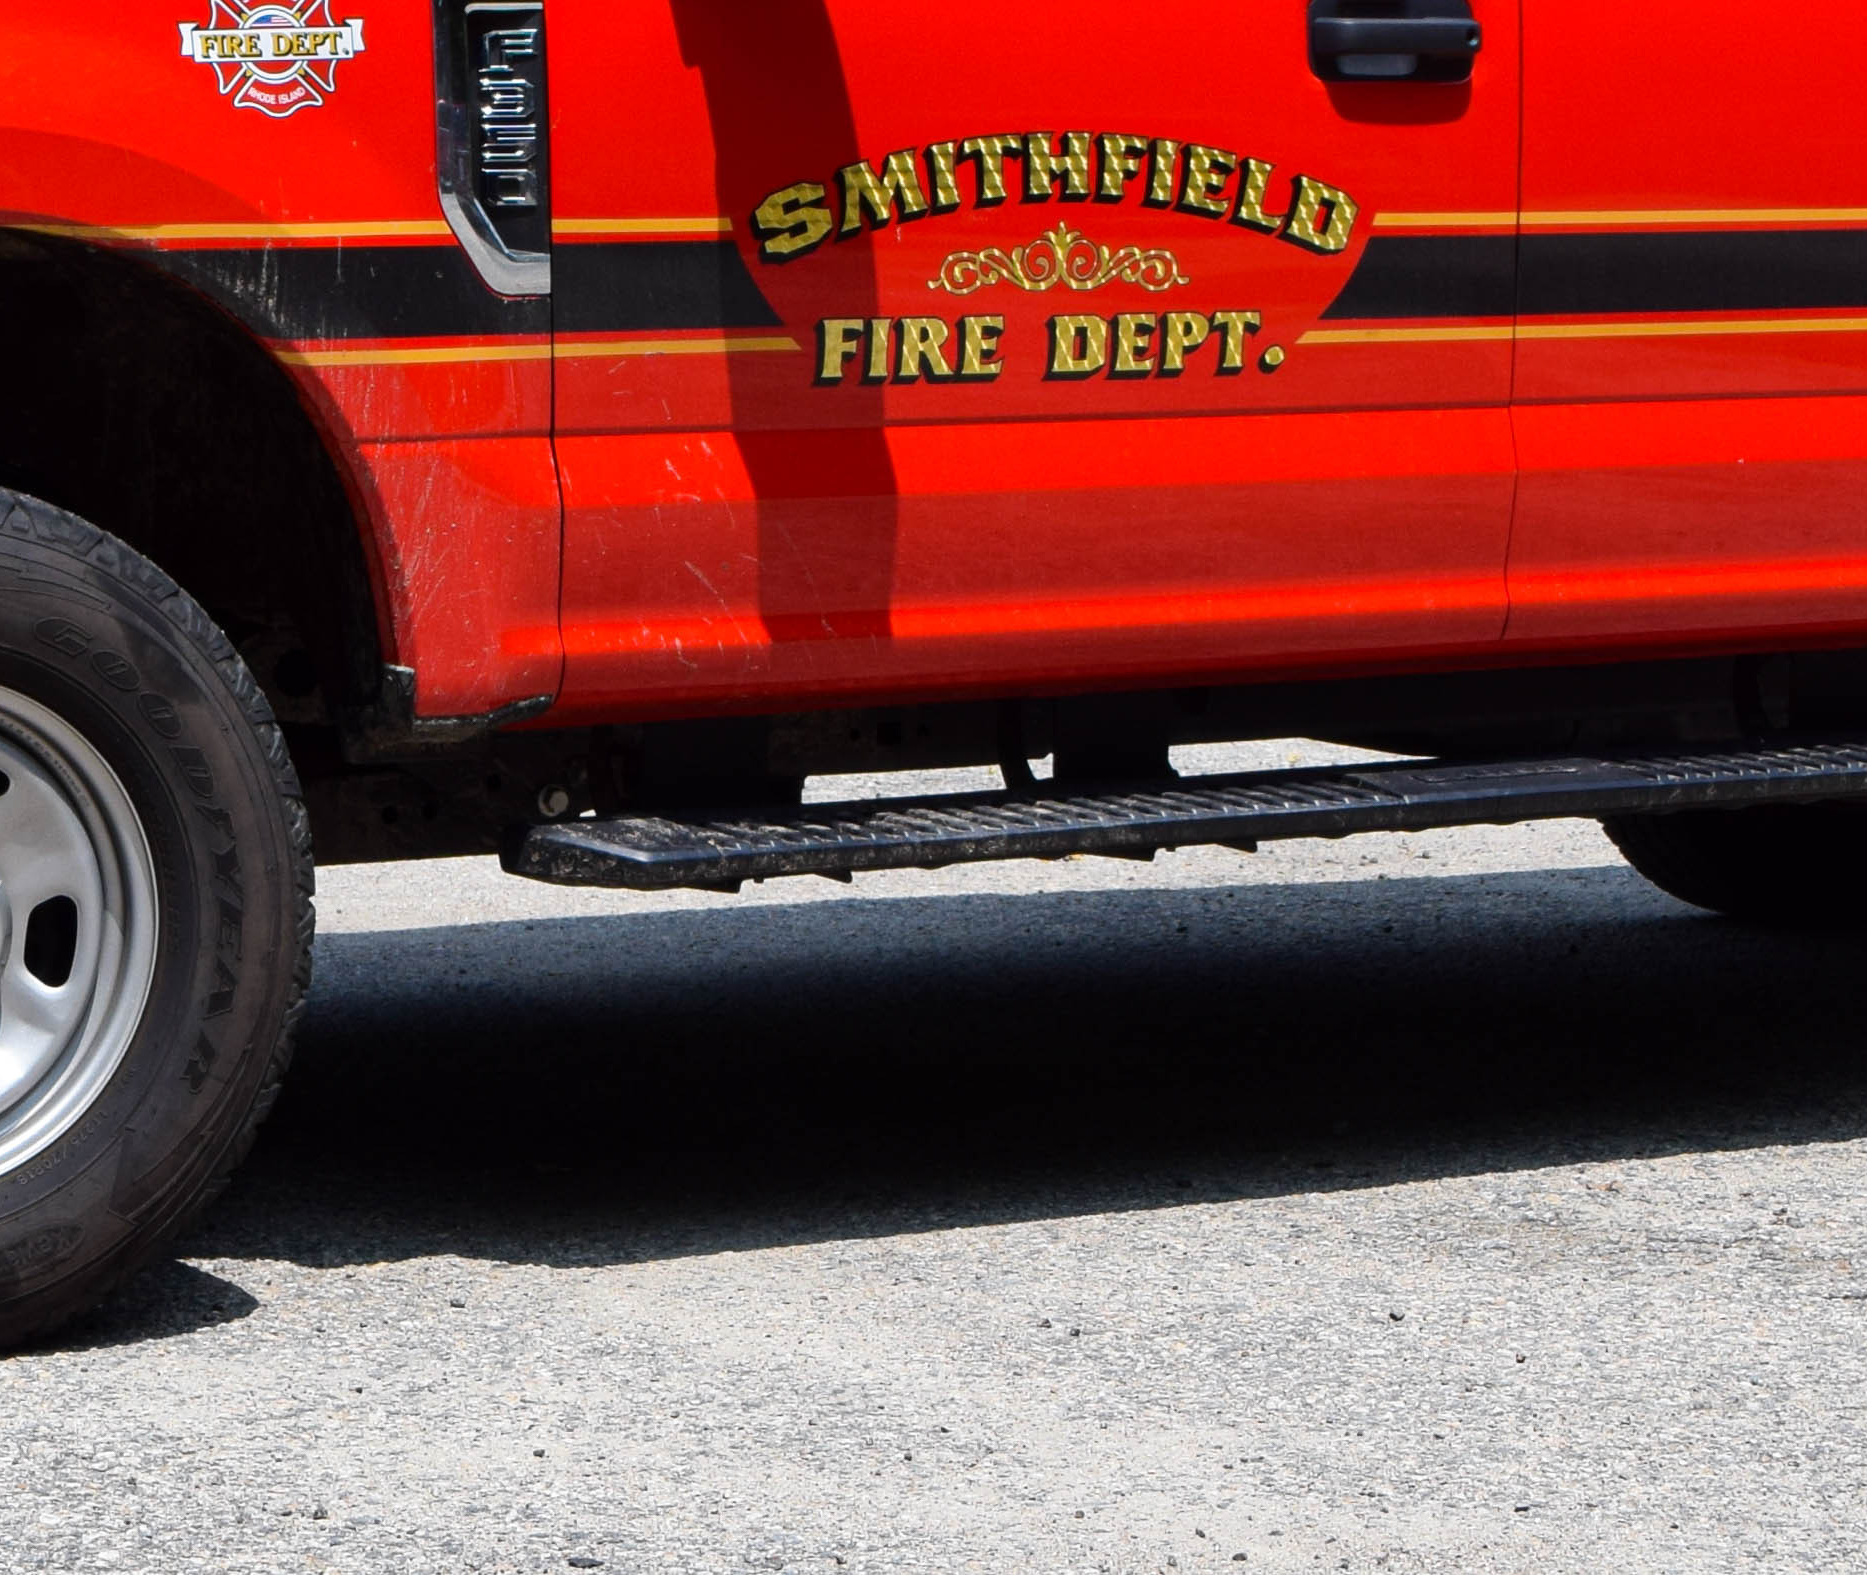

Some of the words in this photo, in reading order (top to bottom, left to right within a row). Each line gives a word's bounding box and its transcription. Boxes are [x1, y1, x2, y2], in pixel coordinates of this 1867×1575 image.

[199, 34, 262, 58] FIRE
[271, 31, 350, 56] DEPT.
[247, 86, 277, 105] RHODE
[278, 86, 307, 105] ISLAND
[751, 131, 1360, 264] SMITHFIELD
[813, 313, 1005, 388] FIRE
[1044, 310, 1287, 388] DEPT.
[34, 617, 238, 1098] GOODYEAR
